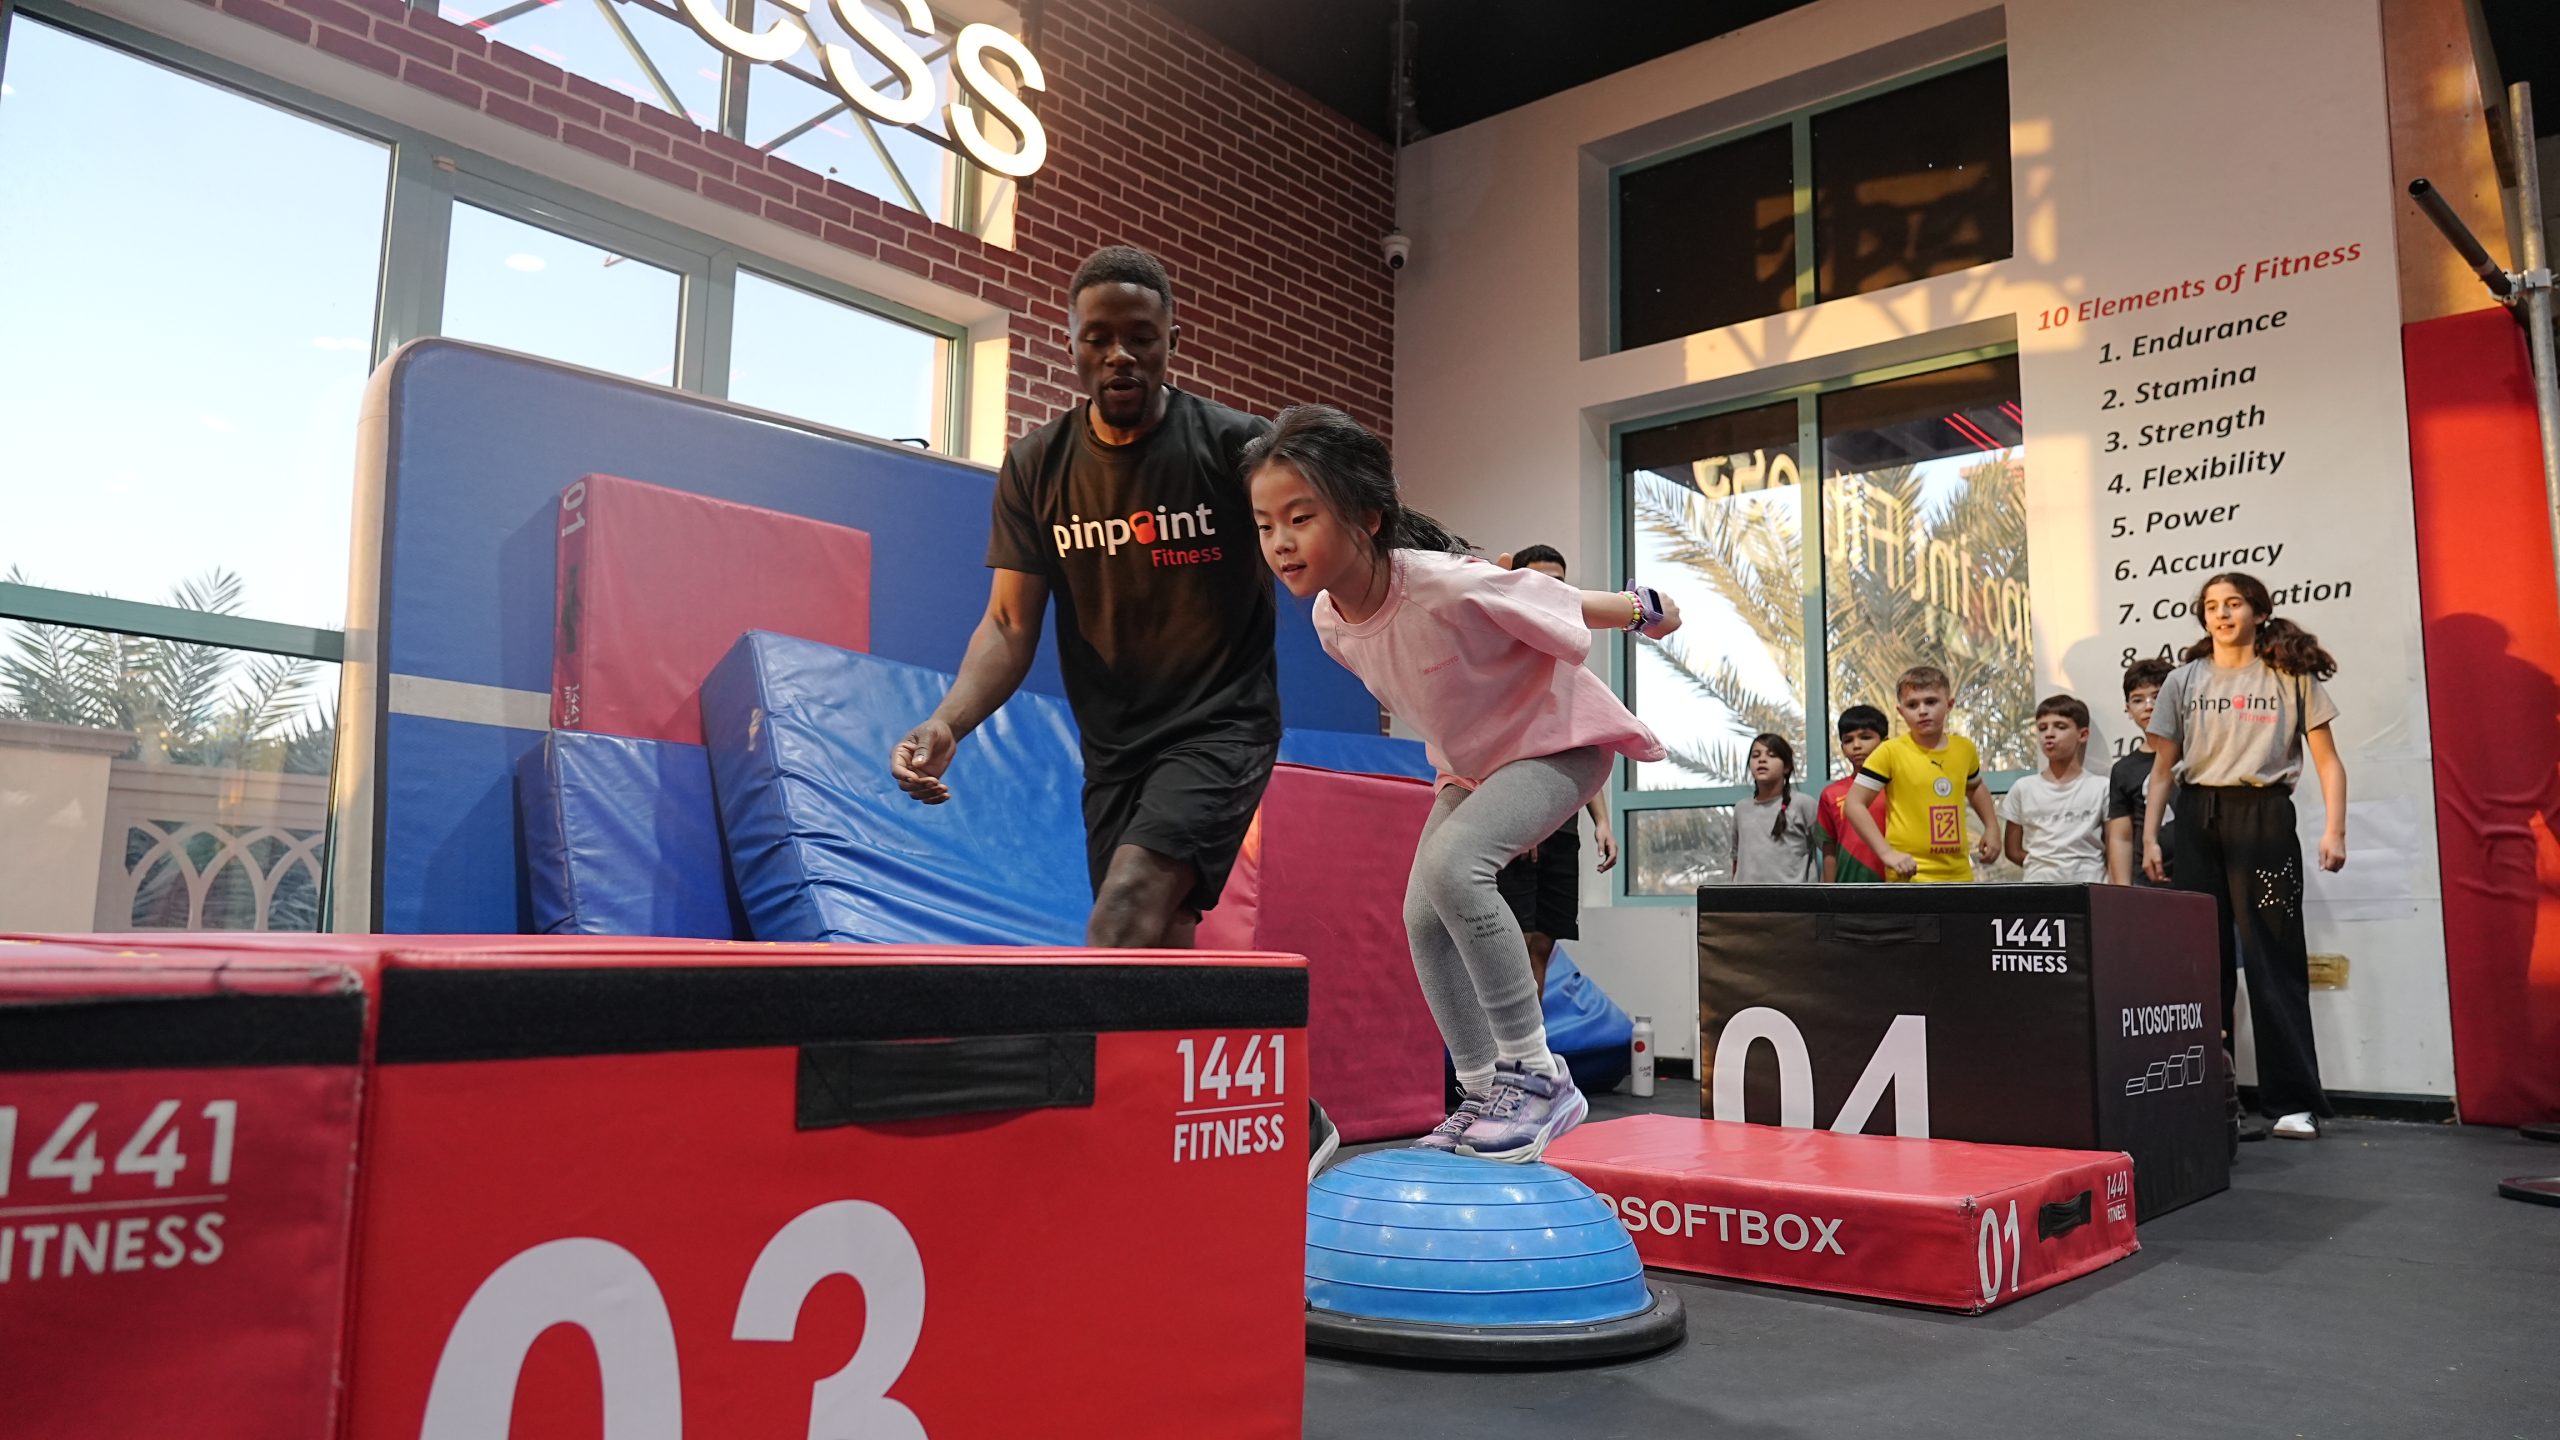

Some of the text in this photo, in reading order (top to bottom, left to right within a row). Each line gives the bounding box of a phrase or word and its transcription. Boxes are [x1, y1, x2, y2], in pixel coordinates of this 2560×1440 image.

[2037, 242, 2361, 331] 10 Elements of Fitness
[2099, 310, 2287, 364] 1. Endurance
[2102, 365, 2257, 410] 2. Stamina
[2105, 405, 2265, 452] 3. Strength
[2108, 450, 2286, 494] 4. Flexibility
[562, 481, 586, 537] 01
[2111, 504, 2240, 538] 5. Power
[1152, 547, 1222, 567] Fitness
[2115, 543, 2284, 581] 6. Accuracy
[2119, 580, 2352, 625] 7. Coation
[1991, 918, 2066, 947] 1441
[1992, 954, 2068, 973] FITNESS
[2122, 1003, 2203, 1037] PLYOSOFTBOX
[1176, 1035, 1285, 1103] 1441
[1713, 1007, 1930, 1138] 04
[1174, 1114, 1285, 1163] FITNESS
[2107, 1170, 2128, 1200] 1441
[0, 1213, 225, 1283] ITNESS
[1978, 1200, 2020, 1303] 01
[420, 1199, 928, 1440] 03
